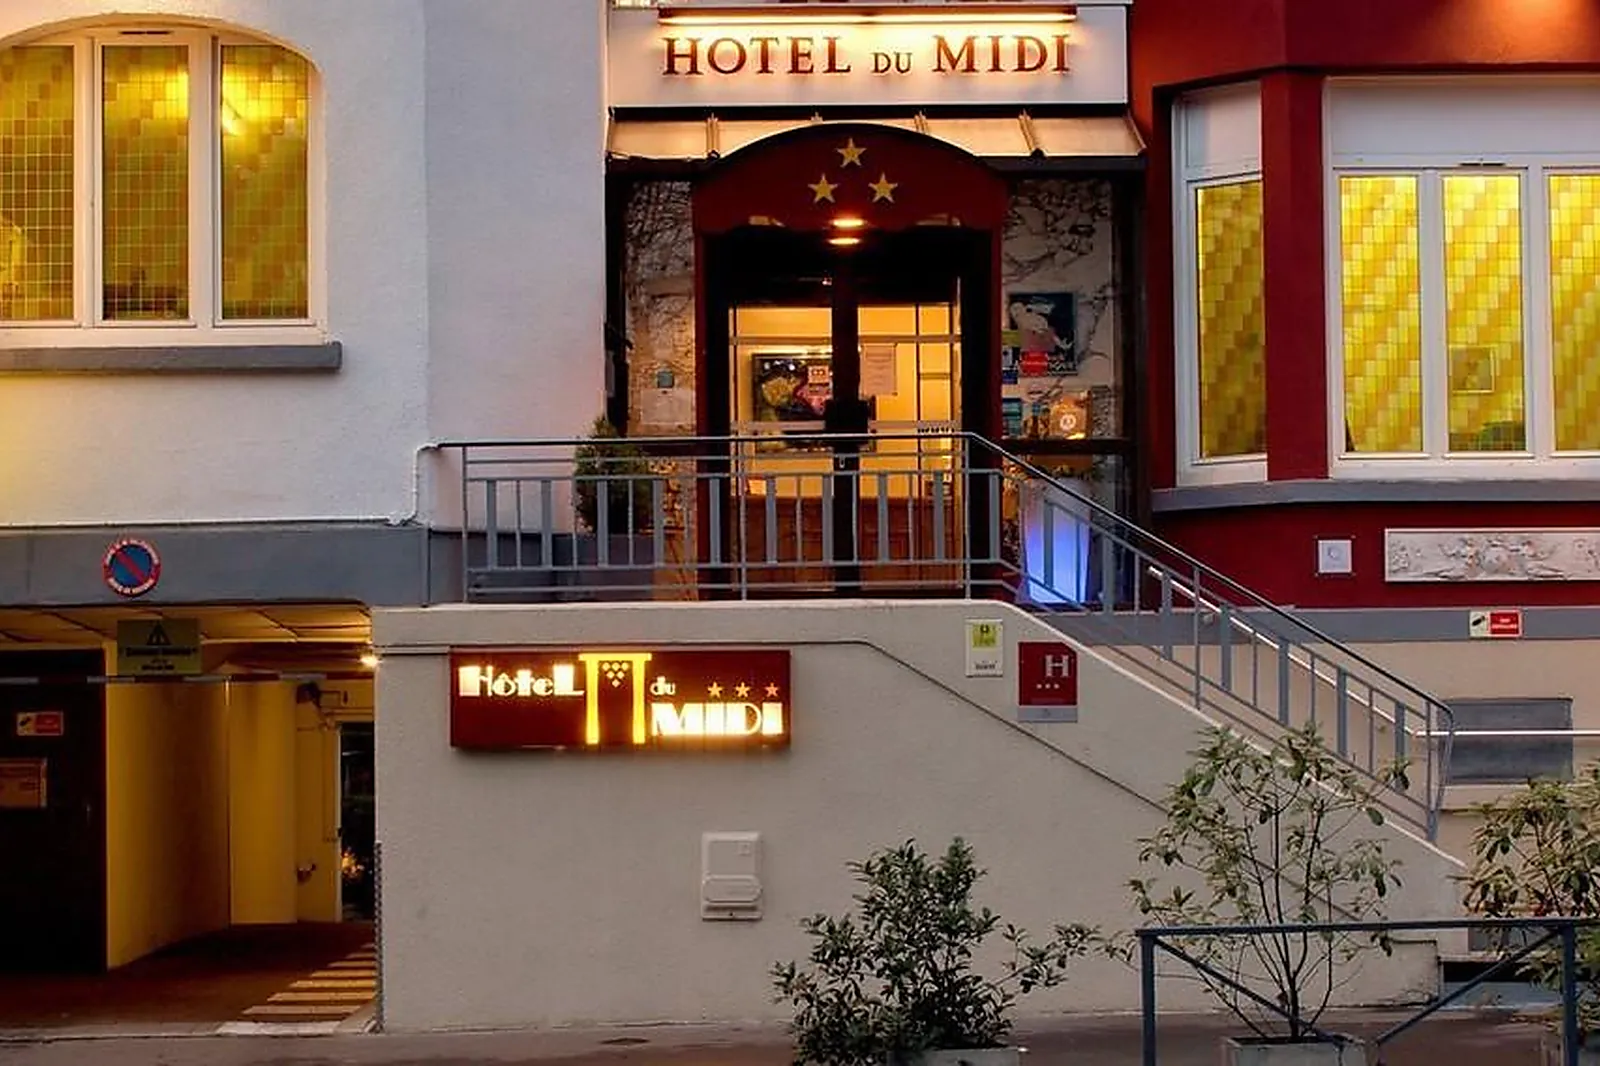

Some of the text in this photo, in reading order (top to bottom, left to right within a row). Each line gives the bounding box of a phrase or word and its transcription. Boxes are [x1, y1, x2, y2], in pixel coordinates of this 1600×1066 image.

[662, 34, 1071, 75] HOTEL DU MIDI
[1044, 654, 1070, 678] H
[650, 676, 676, 696] du
[651, 702, 784, 736] MIDI
